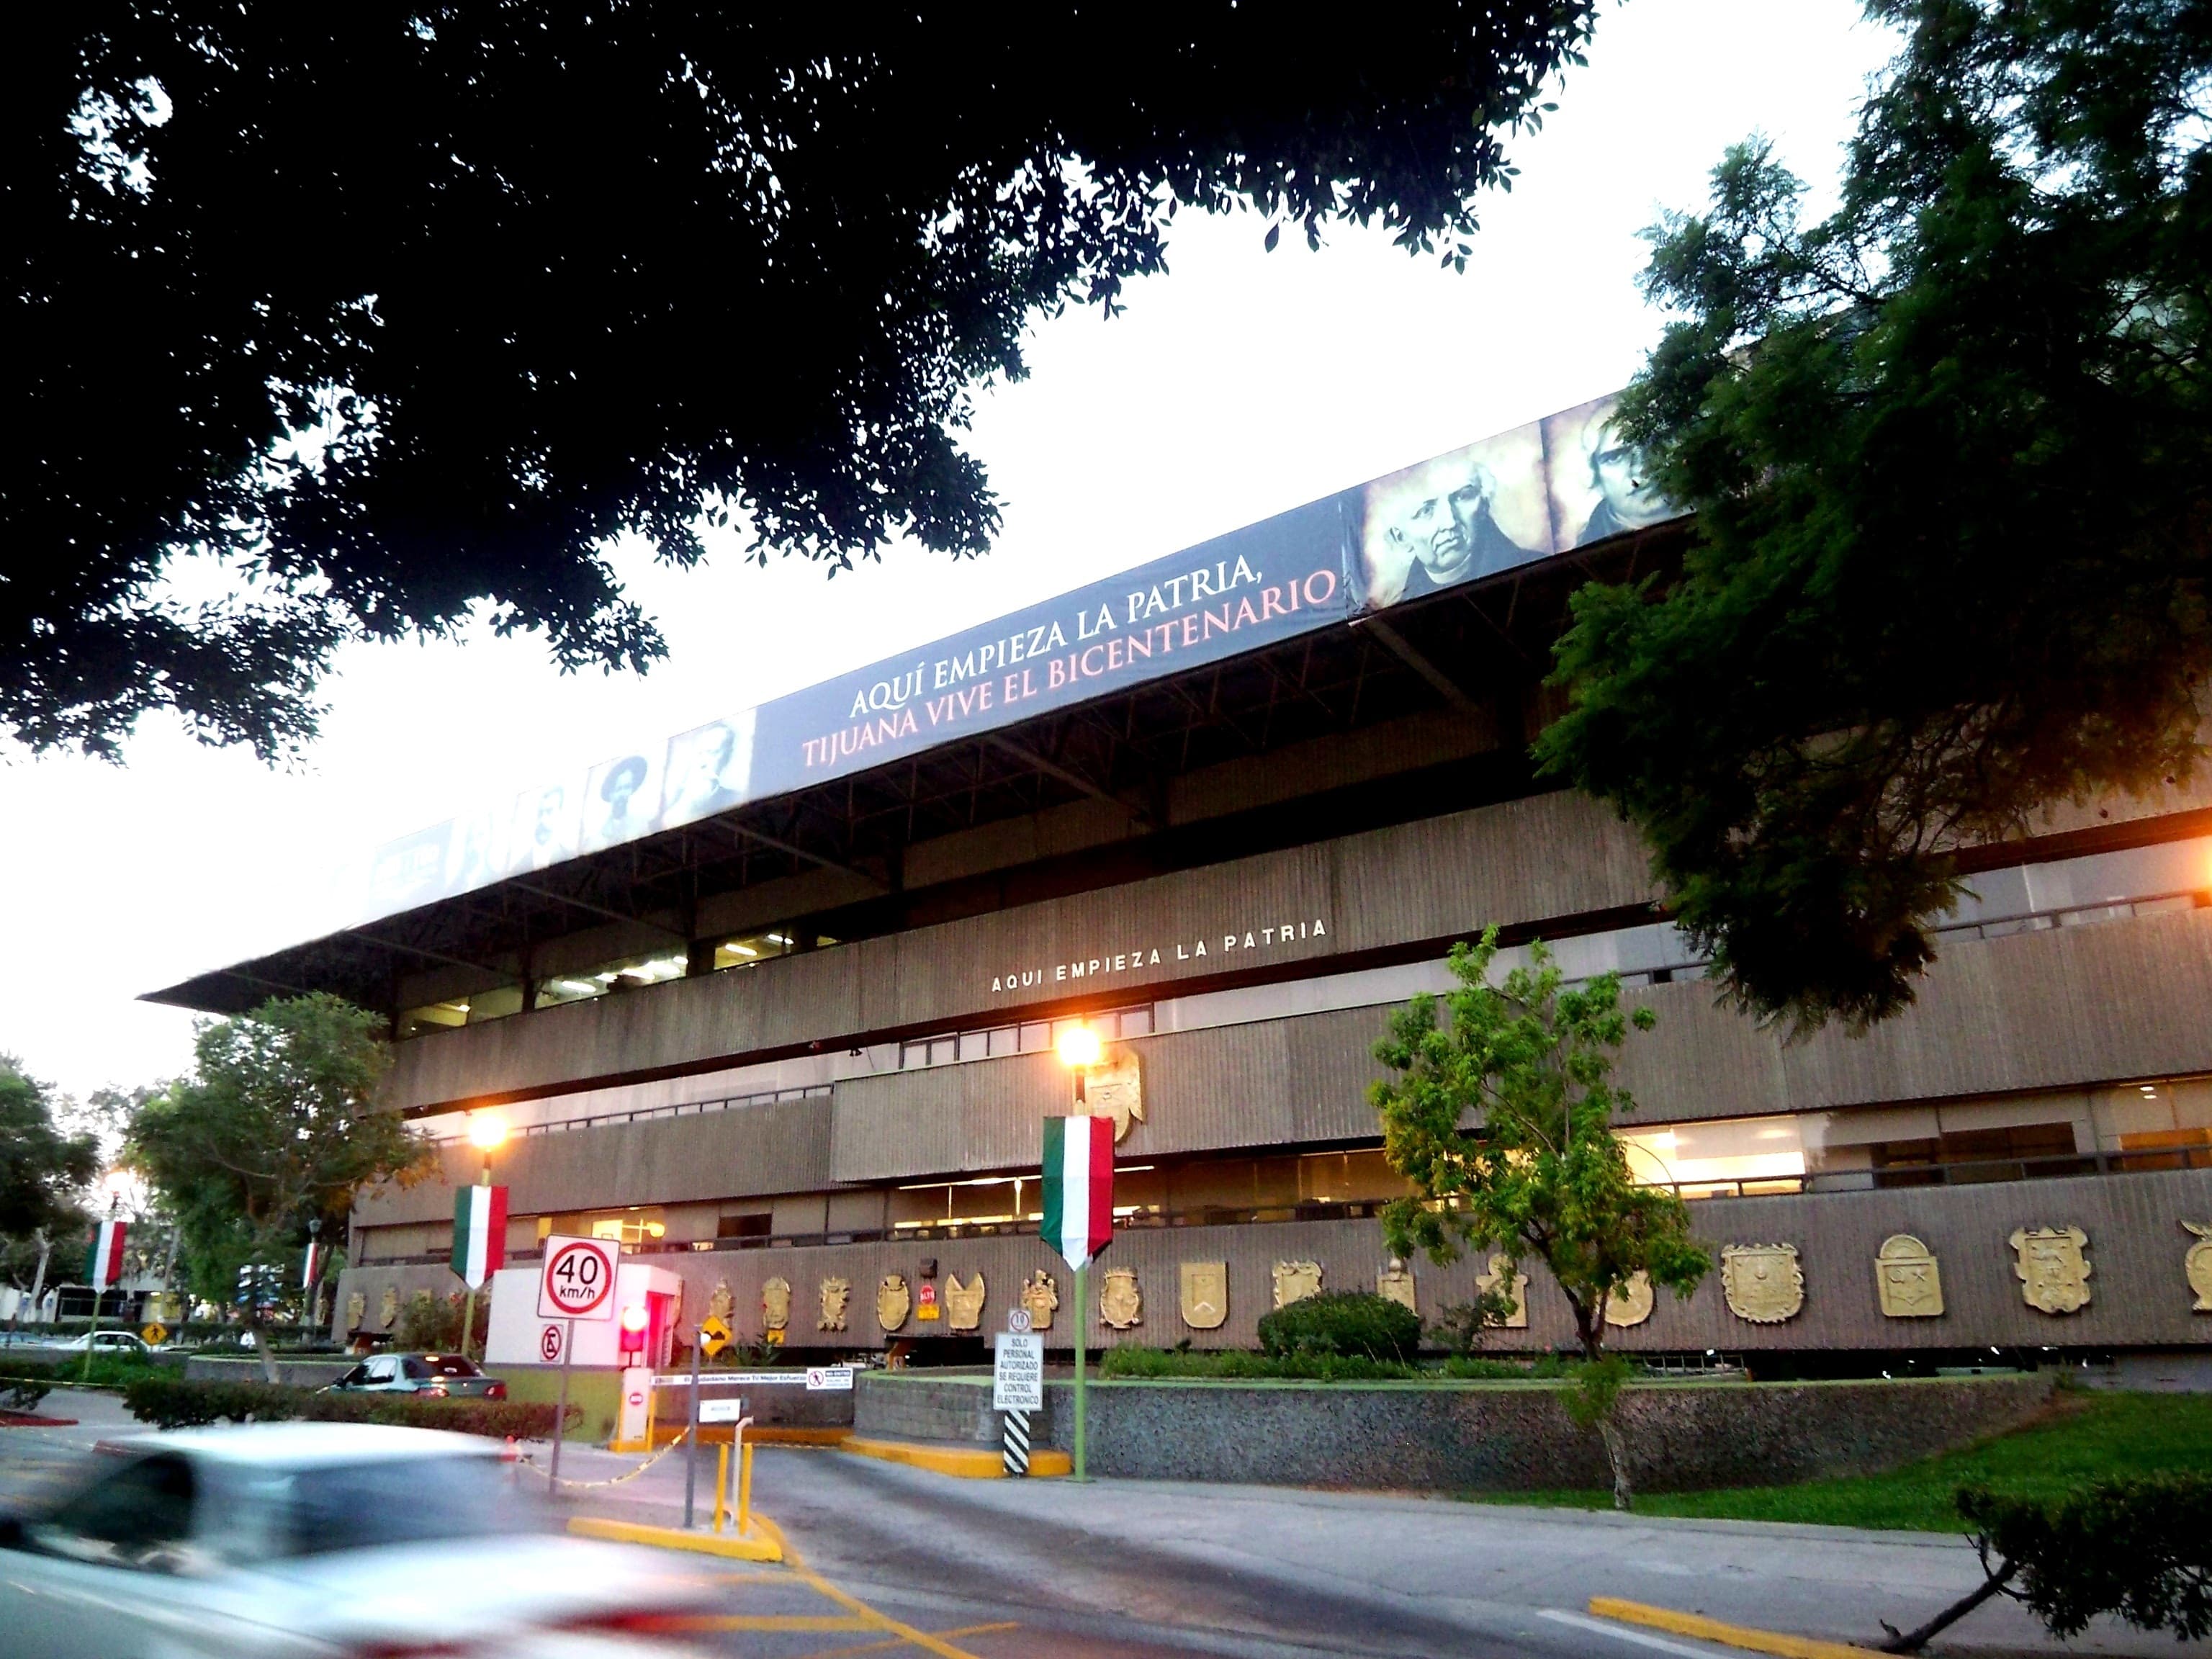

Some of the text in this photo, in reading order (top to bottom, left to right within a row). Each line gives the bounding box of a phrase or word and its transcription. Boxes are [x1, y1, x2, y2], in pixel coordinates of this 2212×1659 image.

[849, 554, 1264, 719] AQUÍ EMPIEZA LA PATRIA,
[802, 569, 1336, 768] TIJUANA VIVE EL BICENTENARIO
[991, 919, 1327, 993] AQUI EMPIEZA LA PATRIA
[556, 1254, 598, 1285] 40
[559, 1285, 595, 1300] km/h
[1011, 1338, 1028, 1347] SOLO
[1003, 1349, 1035, 1359] PERSONAL
[1000, 1360, 1038, 1370] AUTORIZADO
[999, 1372, 1038, 1382] SE REQUIERE
[1004, 1382, 1032, 1393] CONTROL
[997, 1395, 1039, 1405] ELECTRONICO
